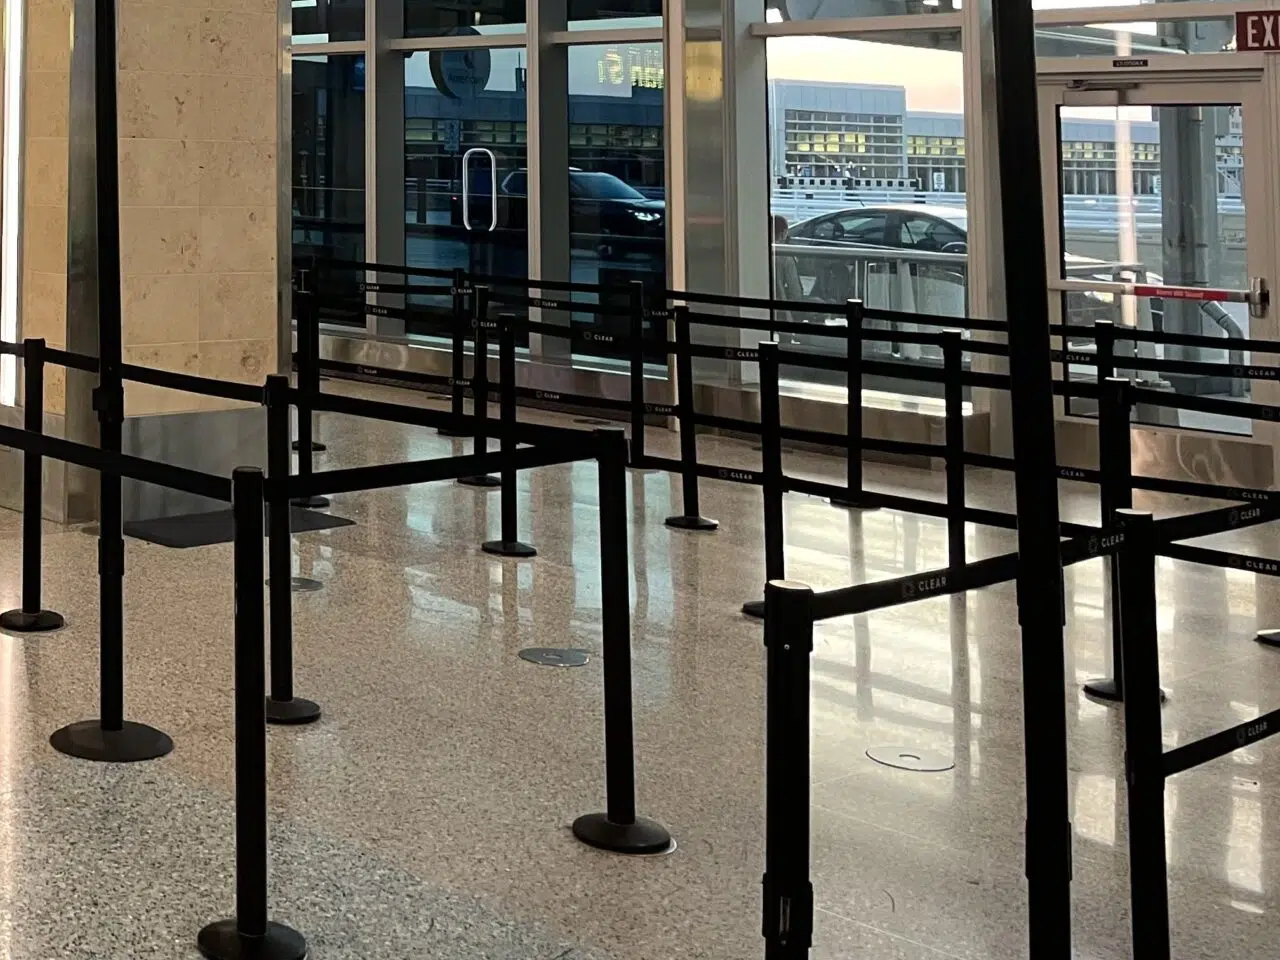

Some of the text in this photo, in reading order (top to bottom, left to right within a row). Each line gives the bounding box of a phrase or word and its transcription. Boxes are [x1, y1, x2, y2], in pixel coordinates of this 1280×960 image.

[593, 334, 614, 342] CLEAR
[737, 350, 760, 359] CLEAR
[1065, 354, 1091, 363] CLEAR
[1247, 369, 1276, 377] CLEAR
[730, 471, 753, 481] CLEAR
[1060, 468, 1085, 478] CLEAR
[1241, 490, 1269, 501] CLEAR
[1239, 507, 1261, 521] CLEAR
[1100, 532, 1125, 548] CLEAR
[1245, 559, 1278, 572] CLEAR
[917, 575, 948, 593] CLEAR
[1247, 720, 1269, 738] CLEAR
